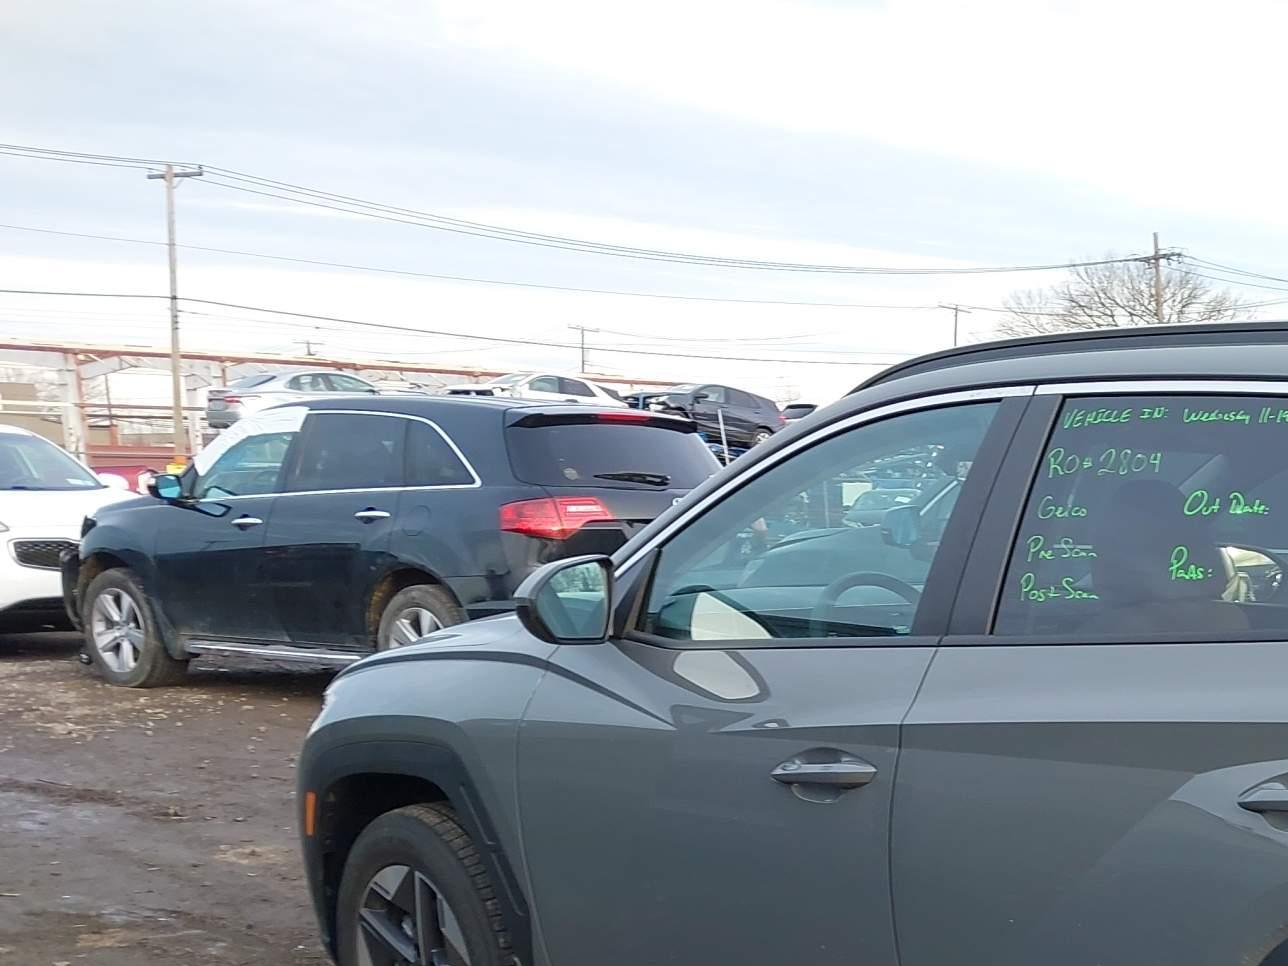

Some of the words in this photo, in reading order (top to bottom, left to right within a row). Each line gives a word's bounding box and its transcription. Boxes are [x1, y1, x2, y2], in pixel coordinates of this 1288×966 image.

[1063, 408, 1133, 429] VEHICLE
[1038, 496, 1088, 519] Geico
[1184, 490, 1220, 516] Out
